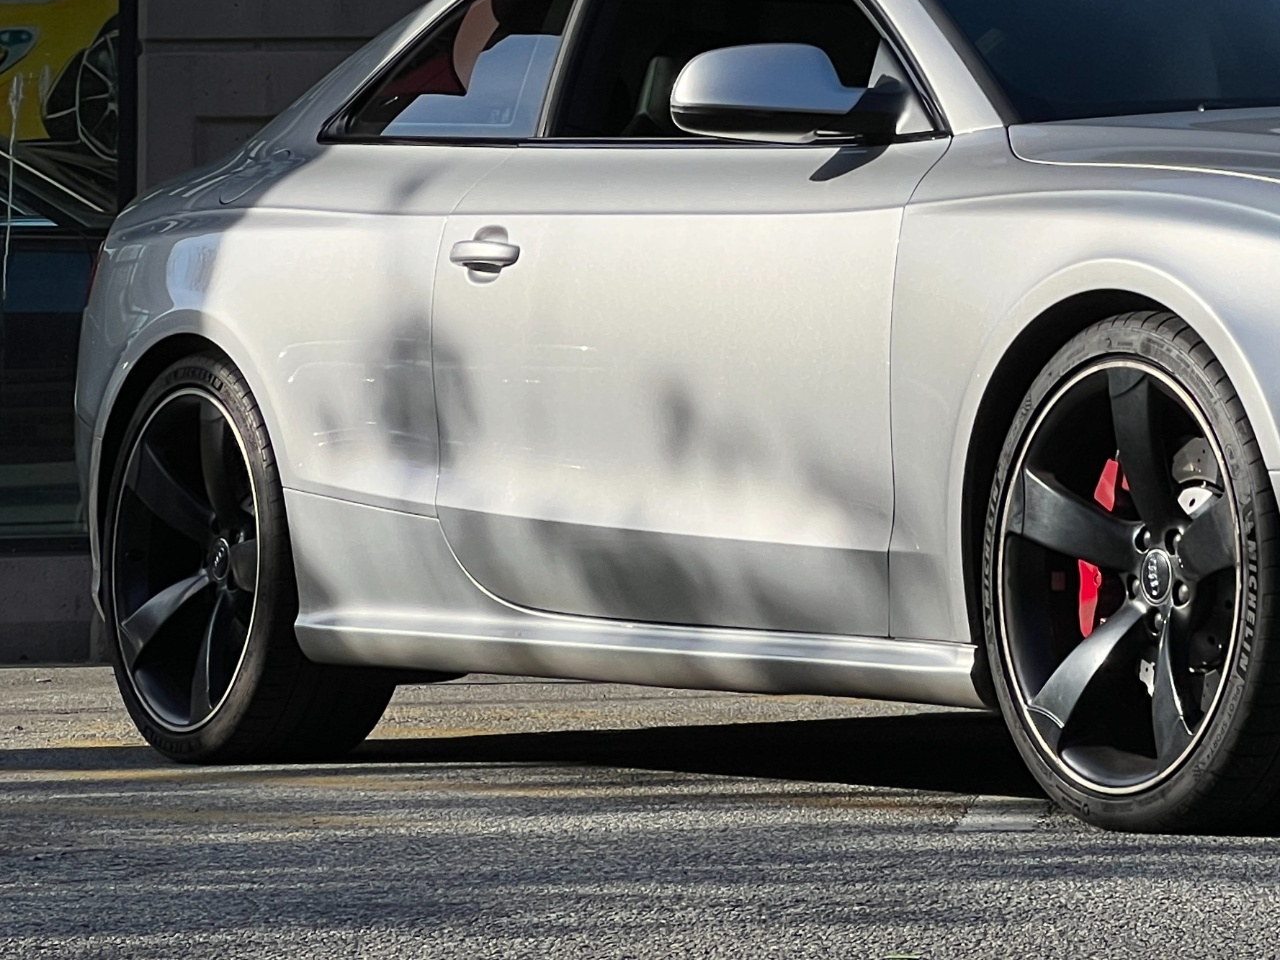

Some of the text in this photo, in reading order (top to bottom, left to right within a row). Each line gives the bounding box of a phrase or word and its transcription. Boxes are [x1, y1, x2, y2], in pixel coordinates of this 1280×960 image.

[983, 483, 1000, 608] MICHELIN
[1238, 540, 1258, 673] MICHELIN
[1208, 685, 1243, 755] PILOT SPORT
